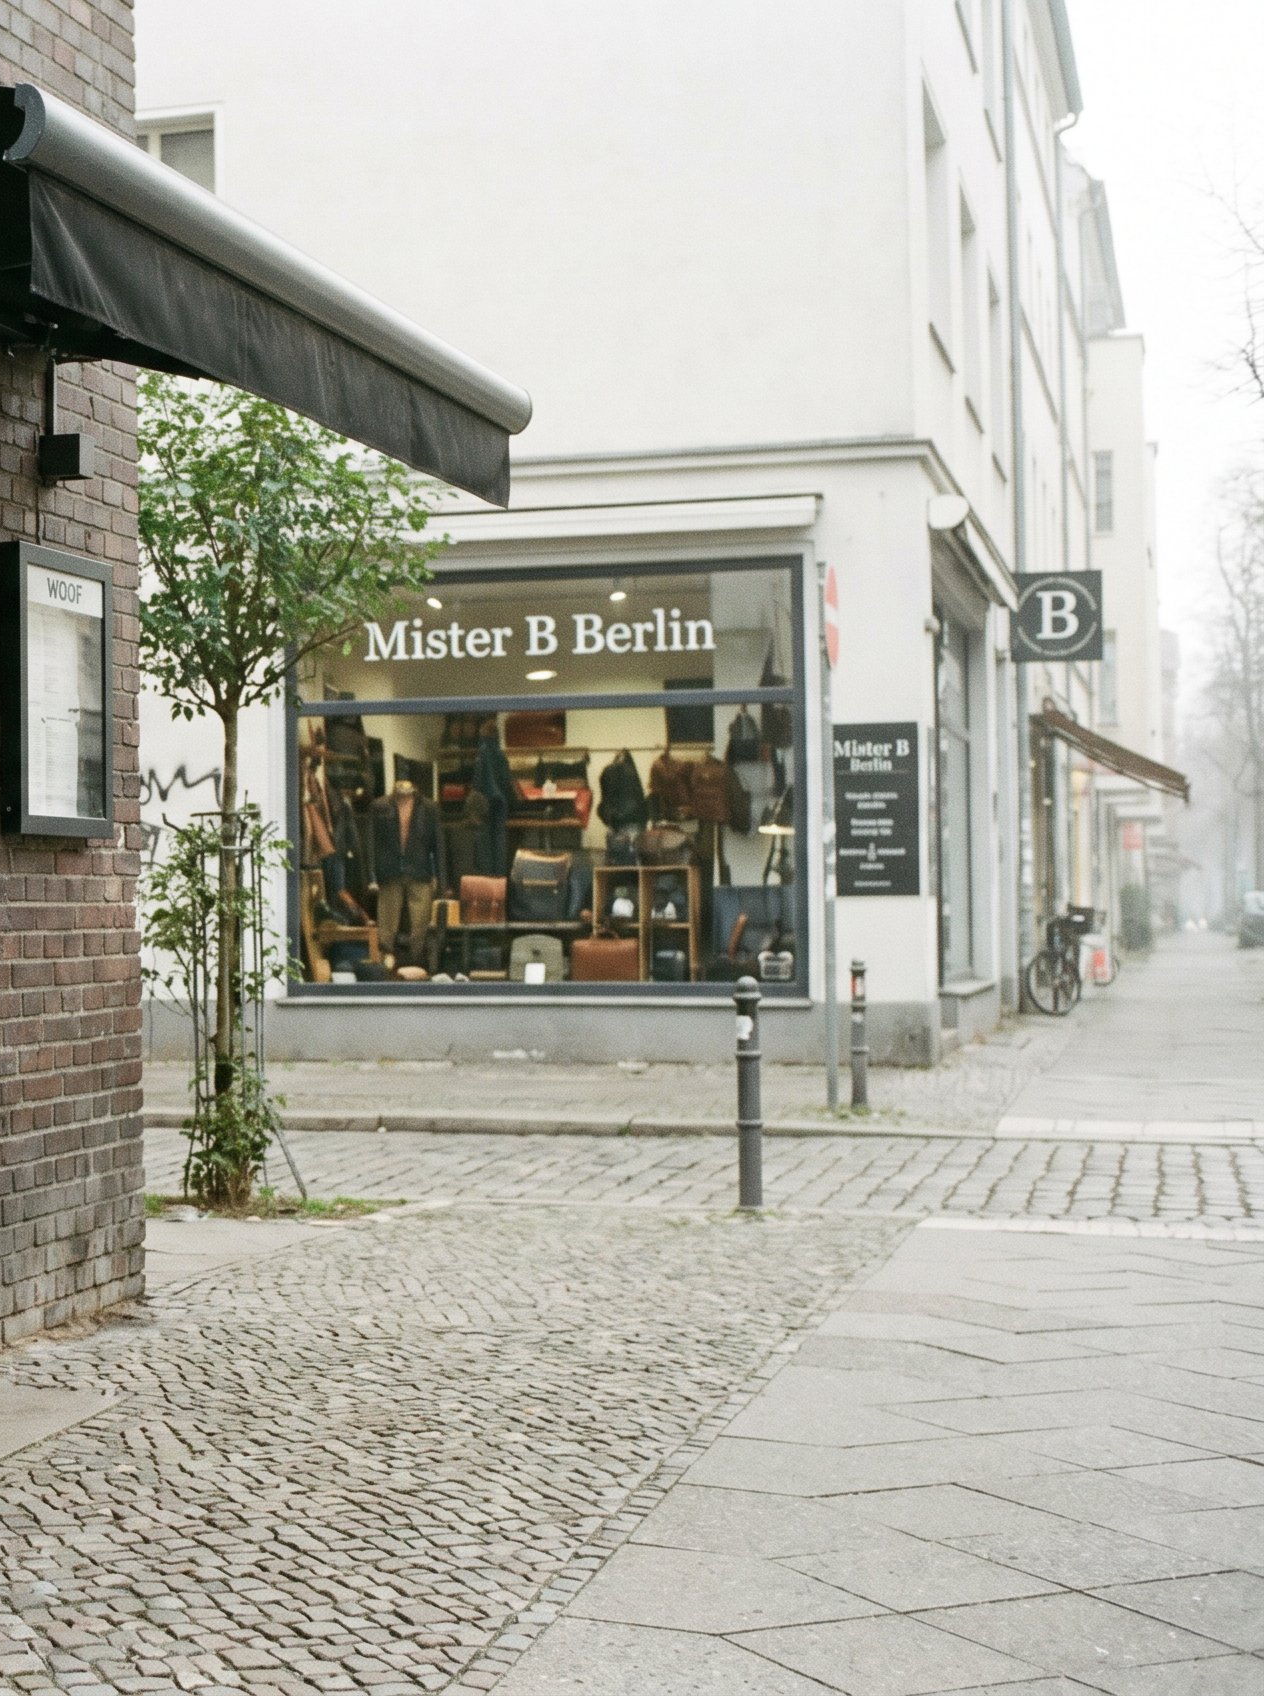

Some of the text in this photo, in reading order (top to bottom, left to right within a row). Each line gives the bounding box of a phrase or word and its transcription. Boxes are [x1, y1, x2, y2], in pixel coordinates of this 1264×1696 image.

[47, 577, 82, 604] WOOF
[1036, 590, 1079, 640] B
[364, 608, 717, 662] Mister B Berlin
[834, 738, 910, 758] Mister B
[850, 758, 893, 772] Berlin
